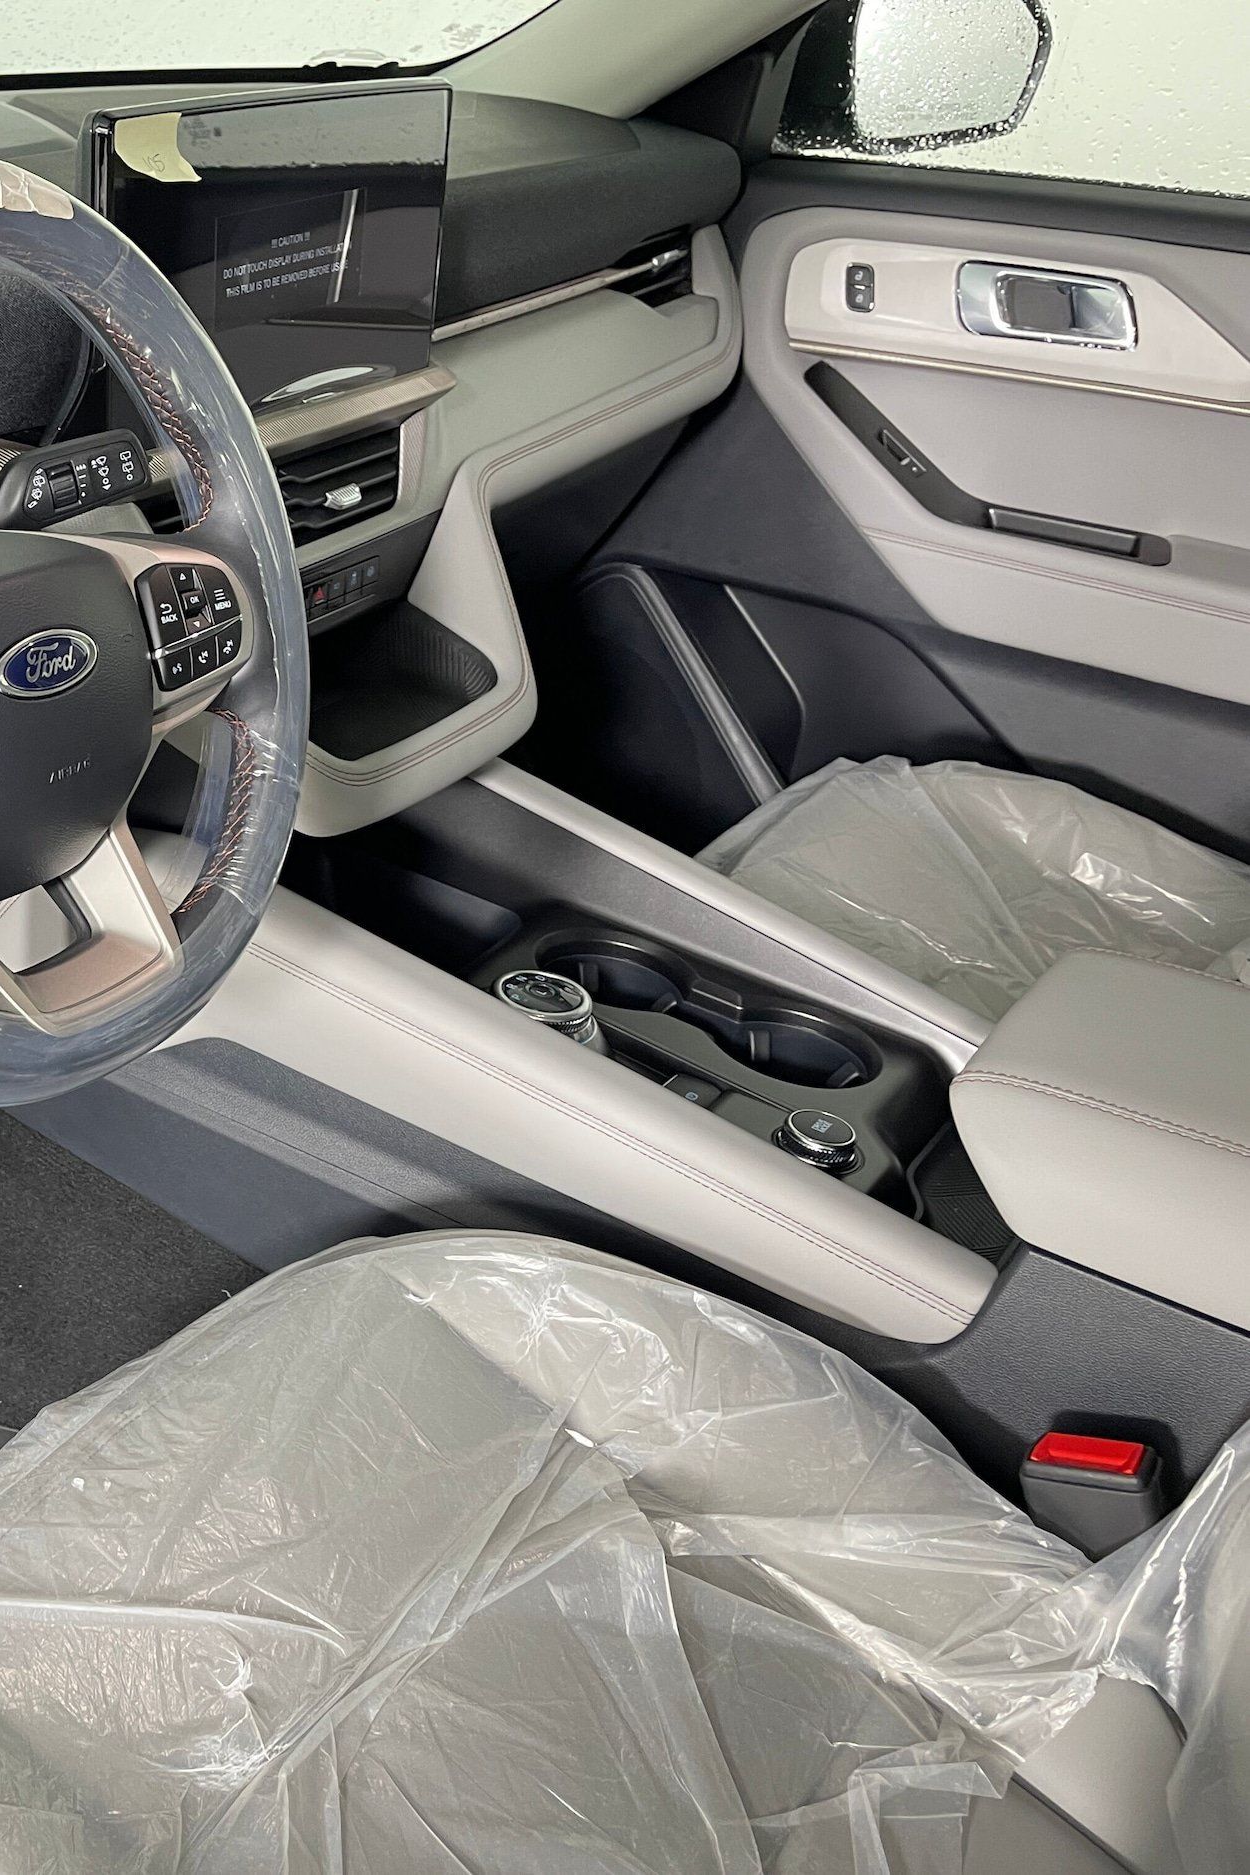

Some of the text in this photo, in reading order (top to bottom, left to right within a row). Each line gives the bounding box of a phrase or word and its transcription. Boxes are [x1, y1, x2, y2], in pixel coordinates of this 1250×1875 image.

[278, 233, 303, 247] CAUTION
[223, 267, 233, 279] DO
[234, 264, 247, 276] NOT
[247, 260, 267, 274] TOUCH
[268, 254, 291, 269] DISPLAY
[292, 249, 314, 263] DURING
[226, 285, 240, 298] THIS
[240, 281, 255, 295] FILM
[256, 280, 263, 291] IS
[263, 278, 271, 289] TO
[272, 275, 281, 287] BE
[281, 269, 308, 284] REMOVED
[308, 263, 330, 278] BEFORE
[190, 595, 200, 604] OK
[214, 600, 232, 611] MENU
[160, 613, 178, 624] BACK
[26, 642, 76, 683] Ford
